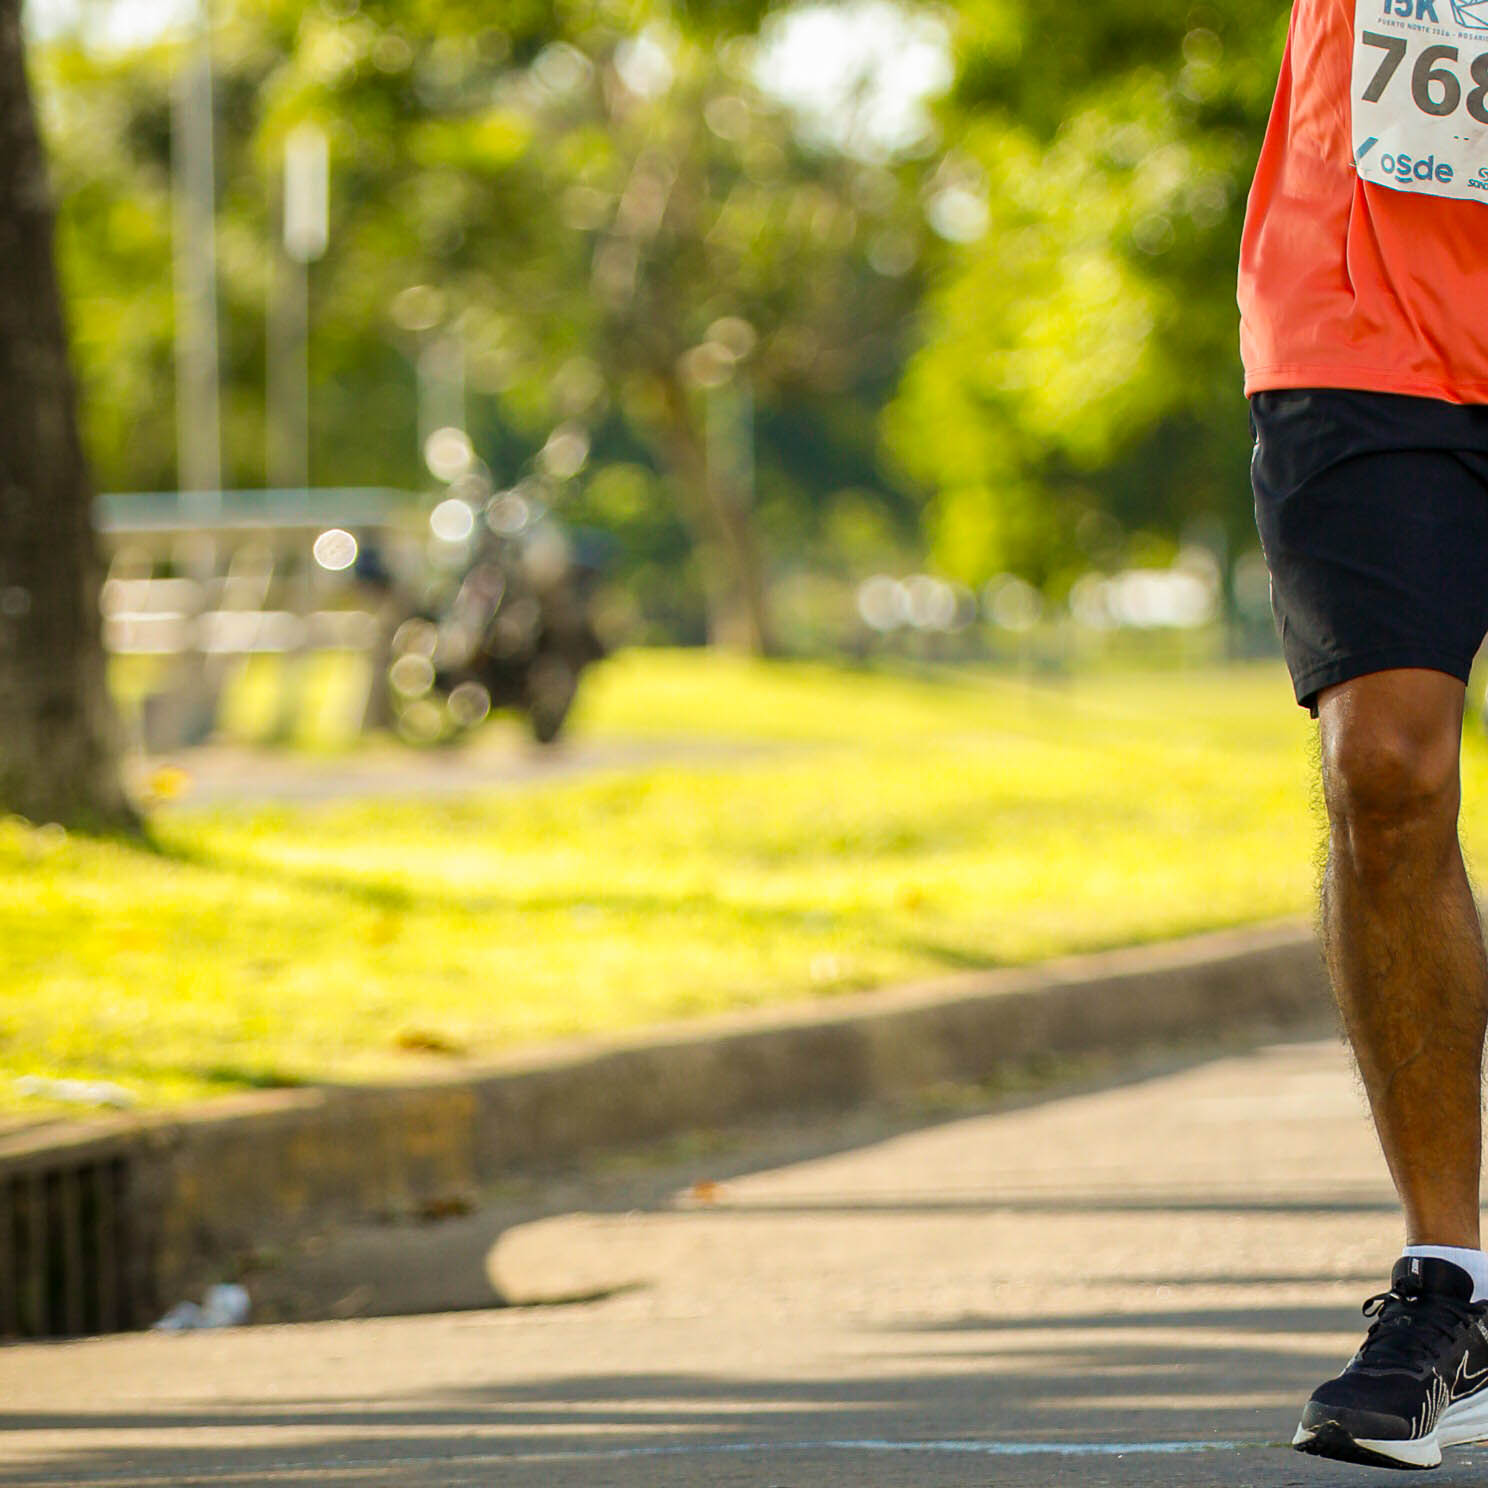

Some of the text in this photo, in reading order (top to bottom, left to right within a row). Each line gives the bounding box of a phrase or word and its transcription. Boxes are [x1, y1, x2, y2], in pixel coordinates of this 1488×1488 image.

[1377, 17, 1405, 28] PUERTO
[1407, 23, 1430, 33] NORTE
[1380, 153, 1454, 184] osde
